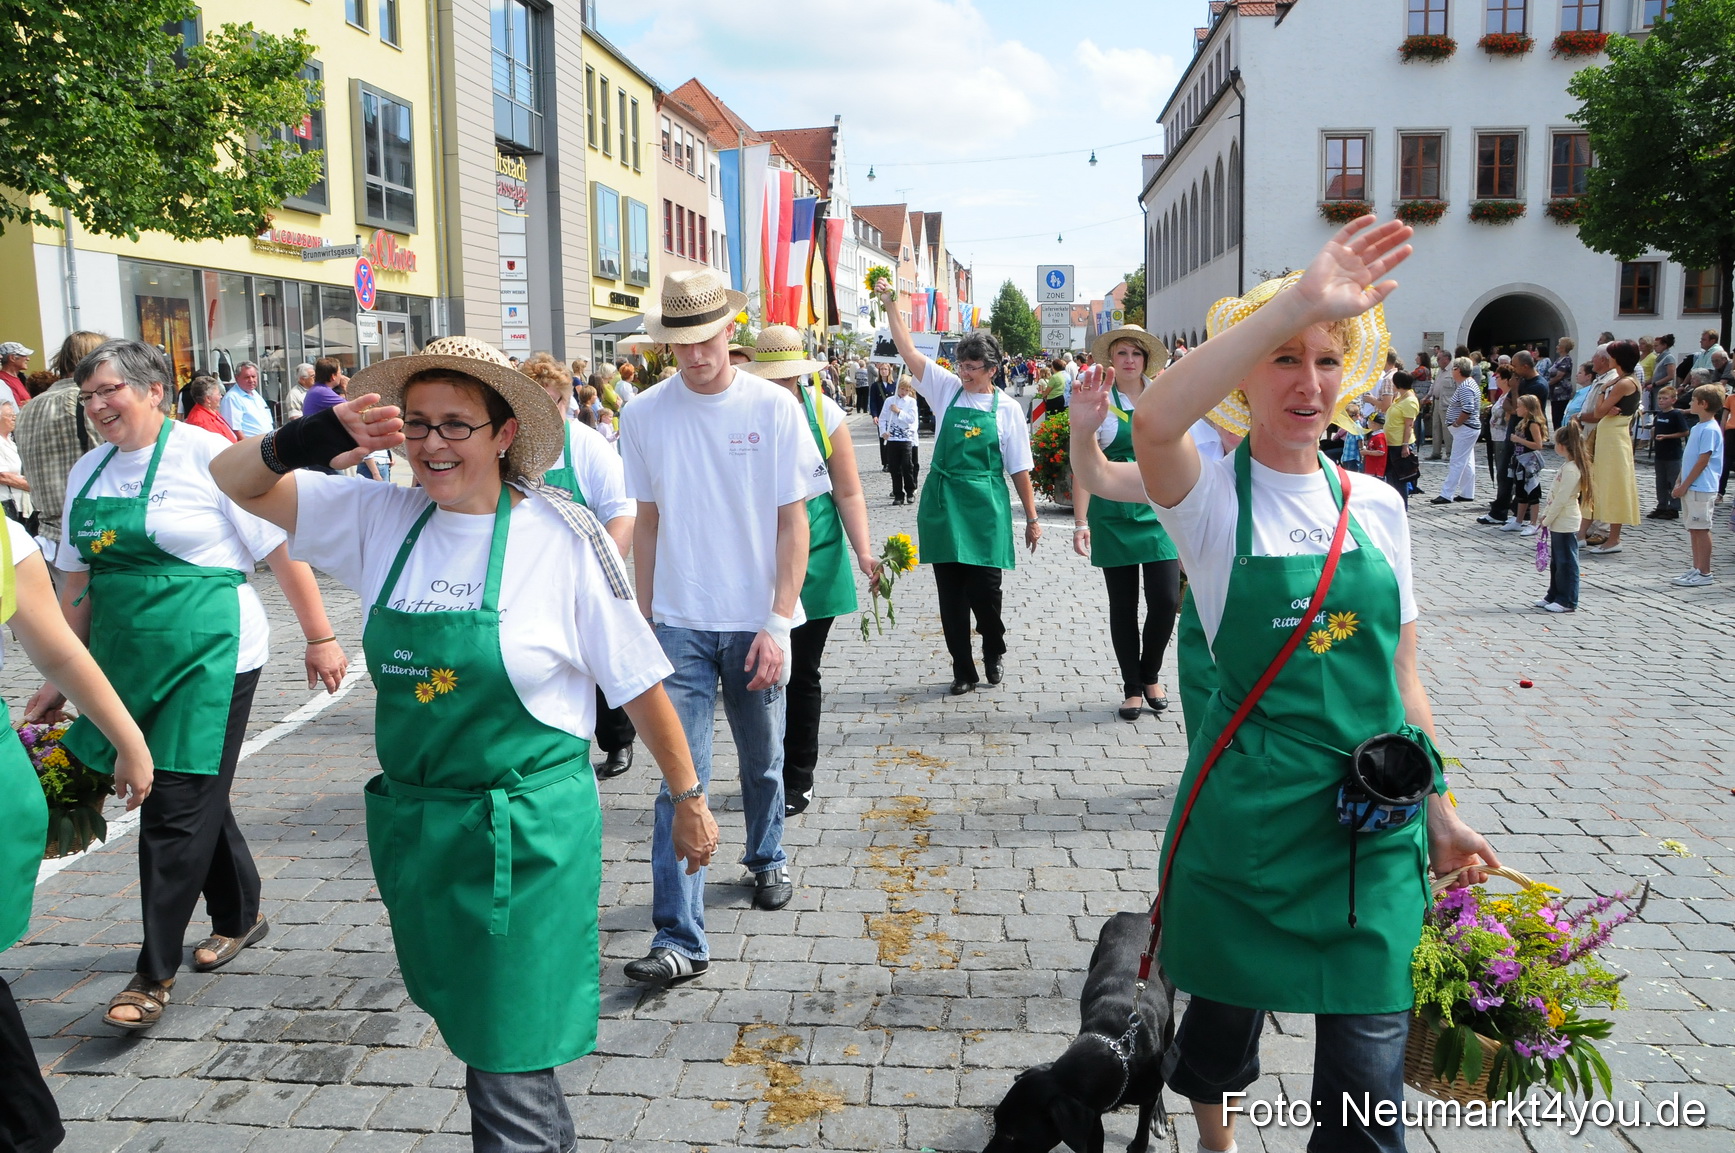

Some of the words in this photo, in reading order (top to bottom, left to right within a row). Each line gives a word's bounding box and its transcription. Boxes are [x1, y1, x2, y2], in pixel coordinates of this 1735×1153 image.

[495, 147, 527, 182] ltstadt
[302, 247, 355, 260] Brunnwirtsgasse
[1290, 527, 1336, 544] OGV
[431, 580, 482, 598] OGV
[393, 650, 413, 661] OGV
[381, 664, 429, 678] Rittershof
